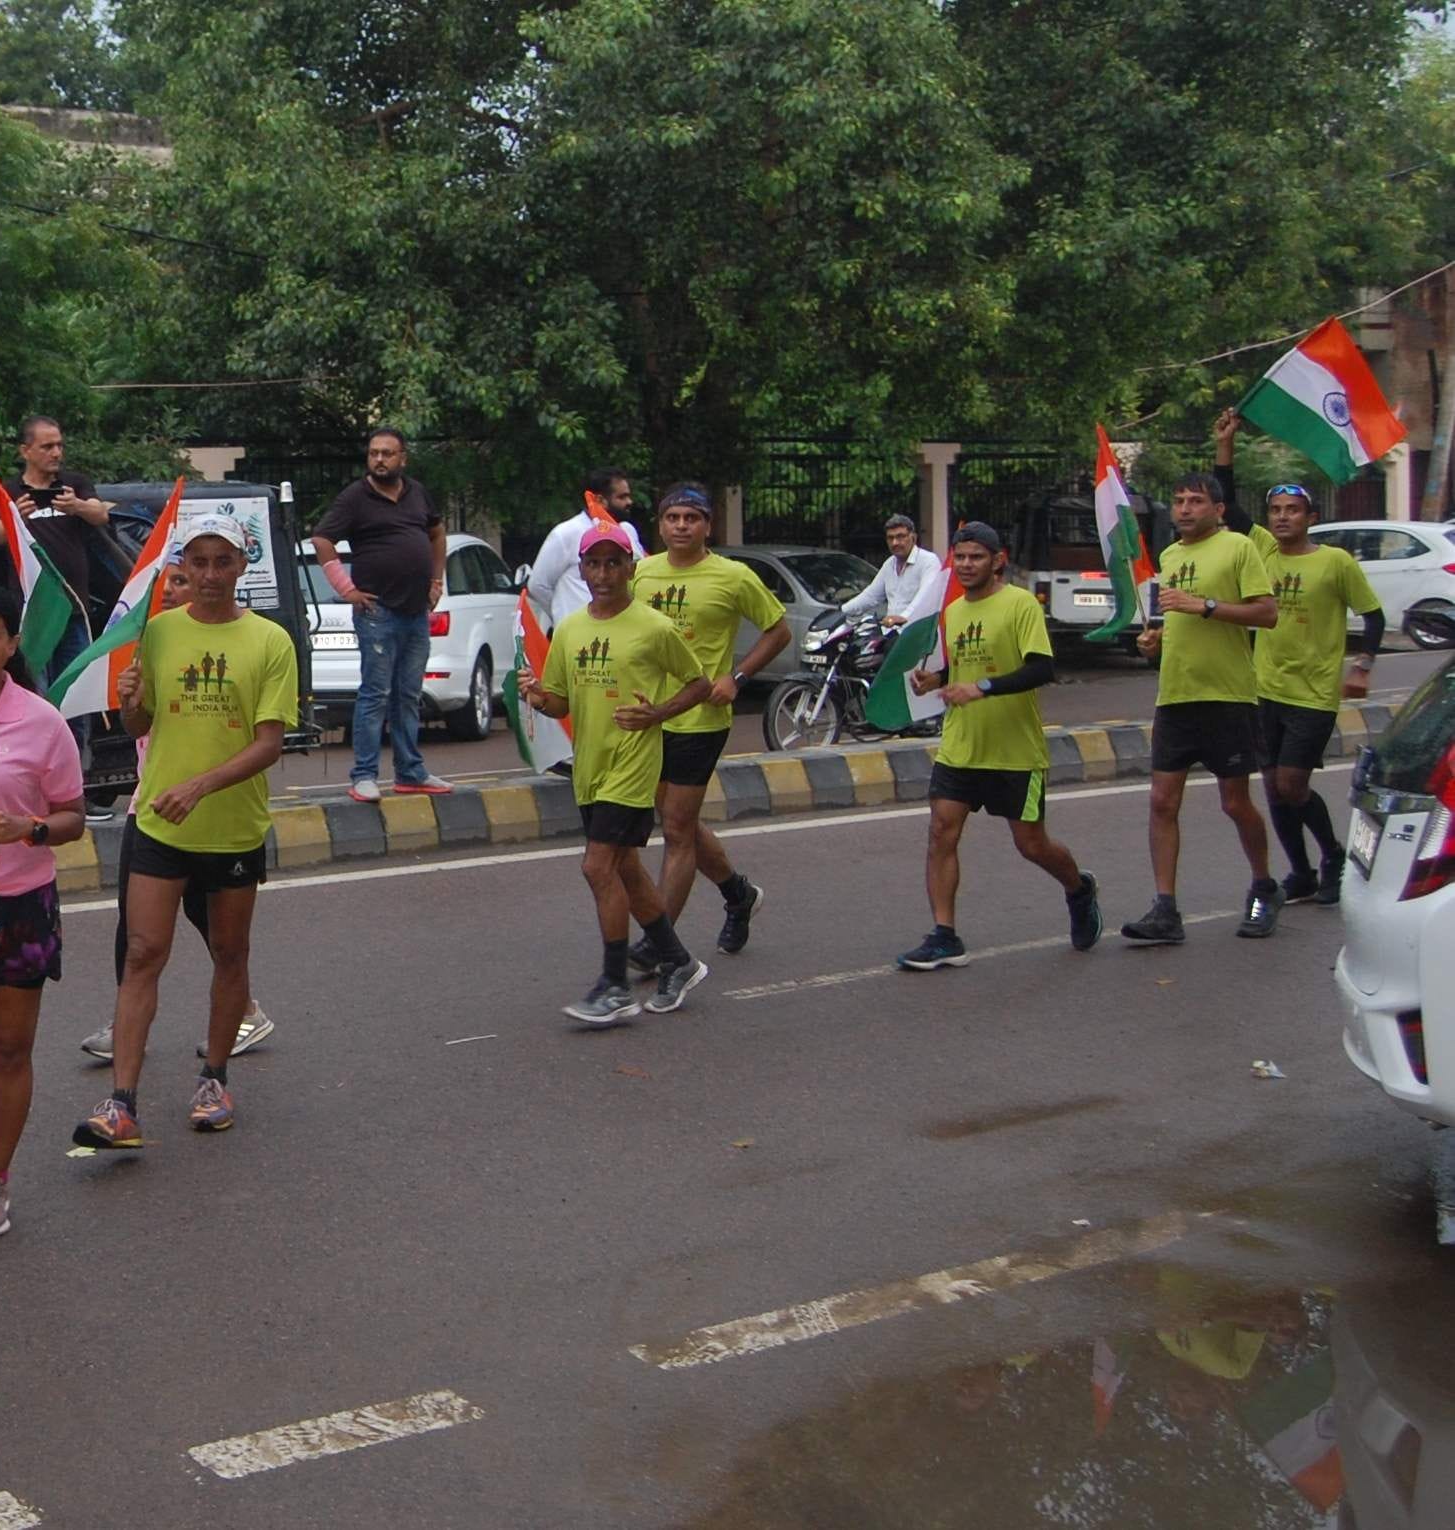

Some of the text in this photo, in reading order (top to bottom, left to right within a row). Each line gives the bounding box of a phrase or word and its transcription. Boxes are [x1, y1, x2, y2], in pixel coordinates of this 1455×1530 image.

[180, 694, 231, 703] THE GREAT
[192, 703, 238, 713] INDIA RUN
